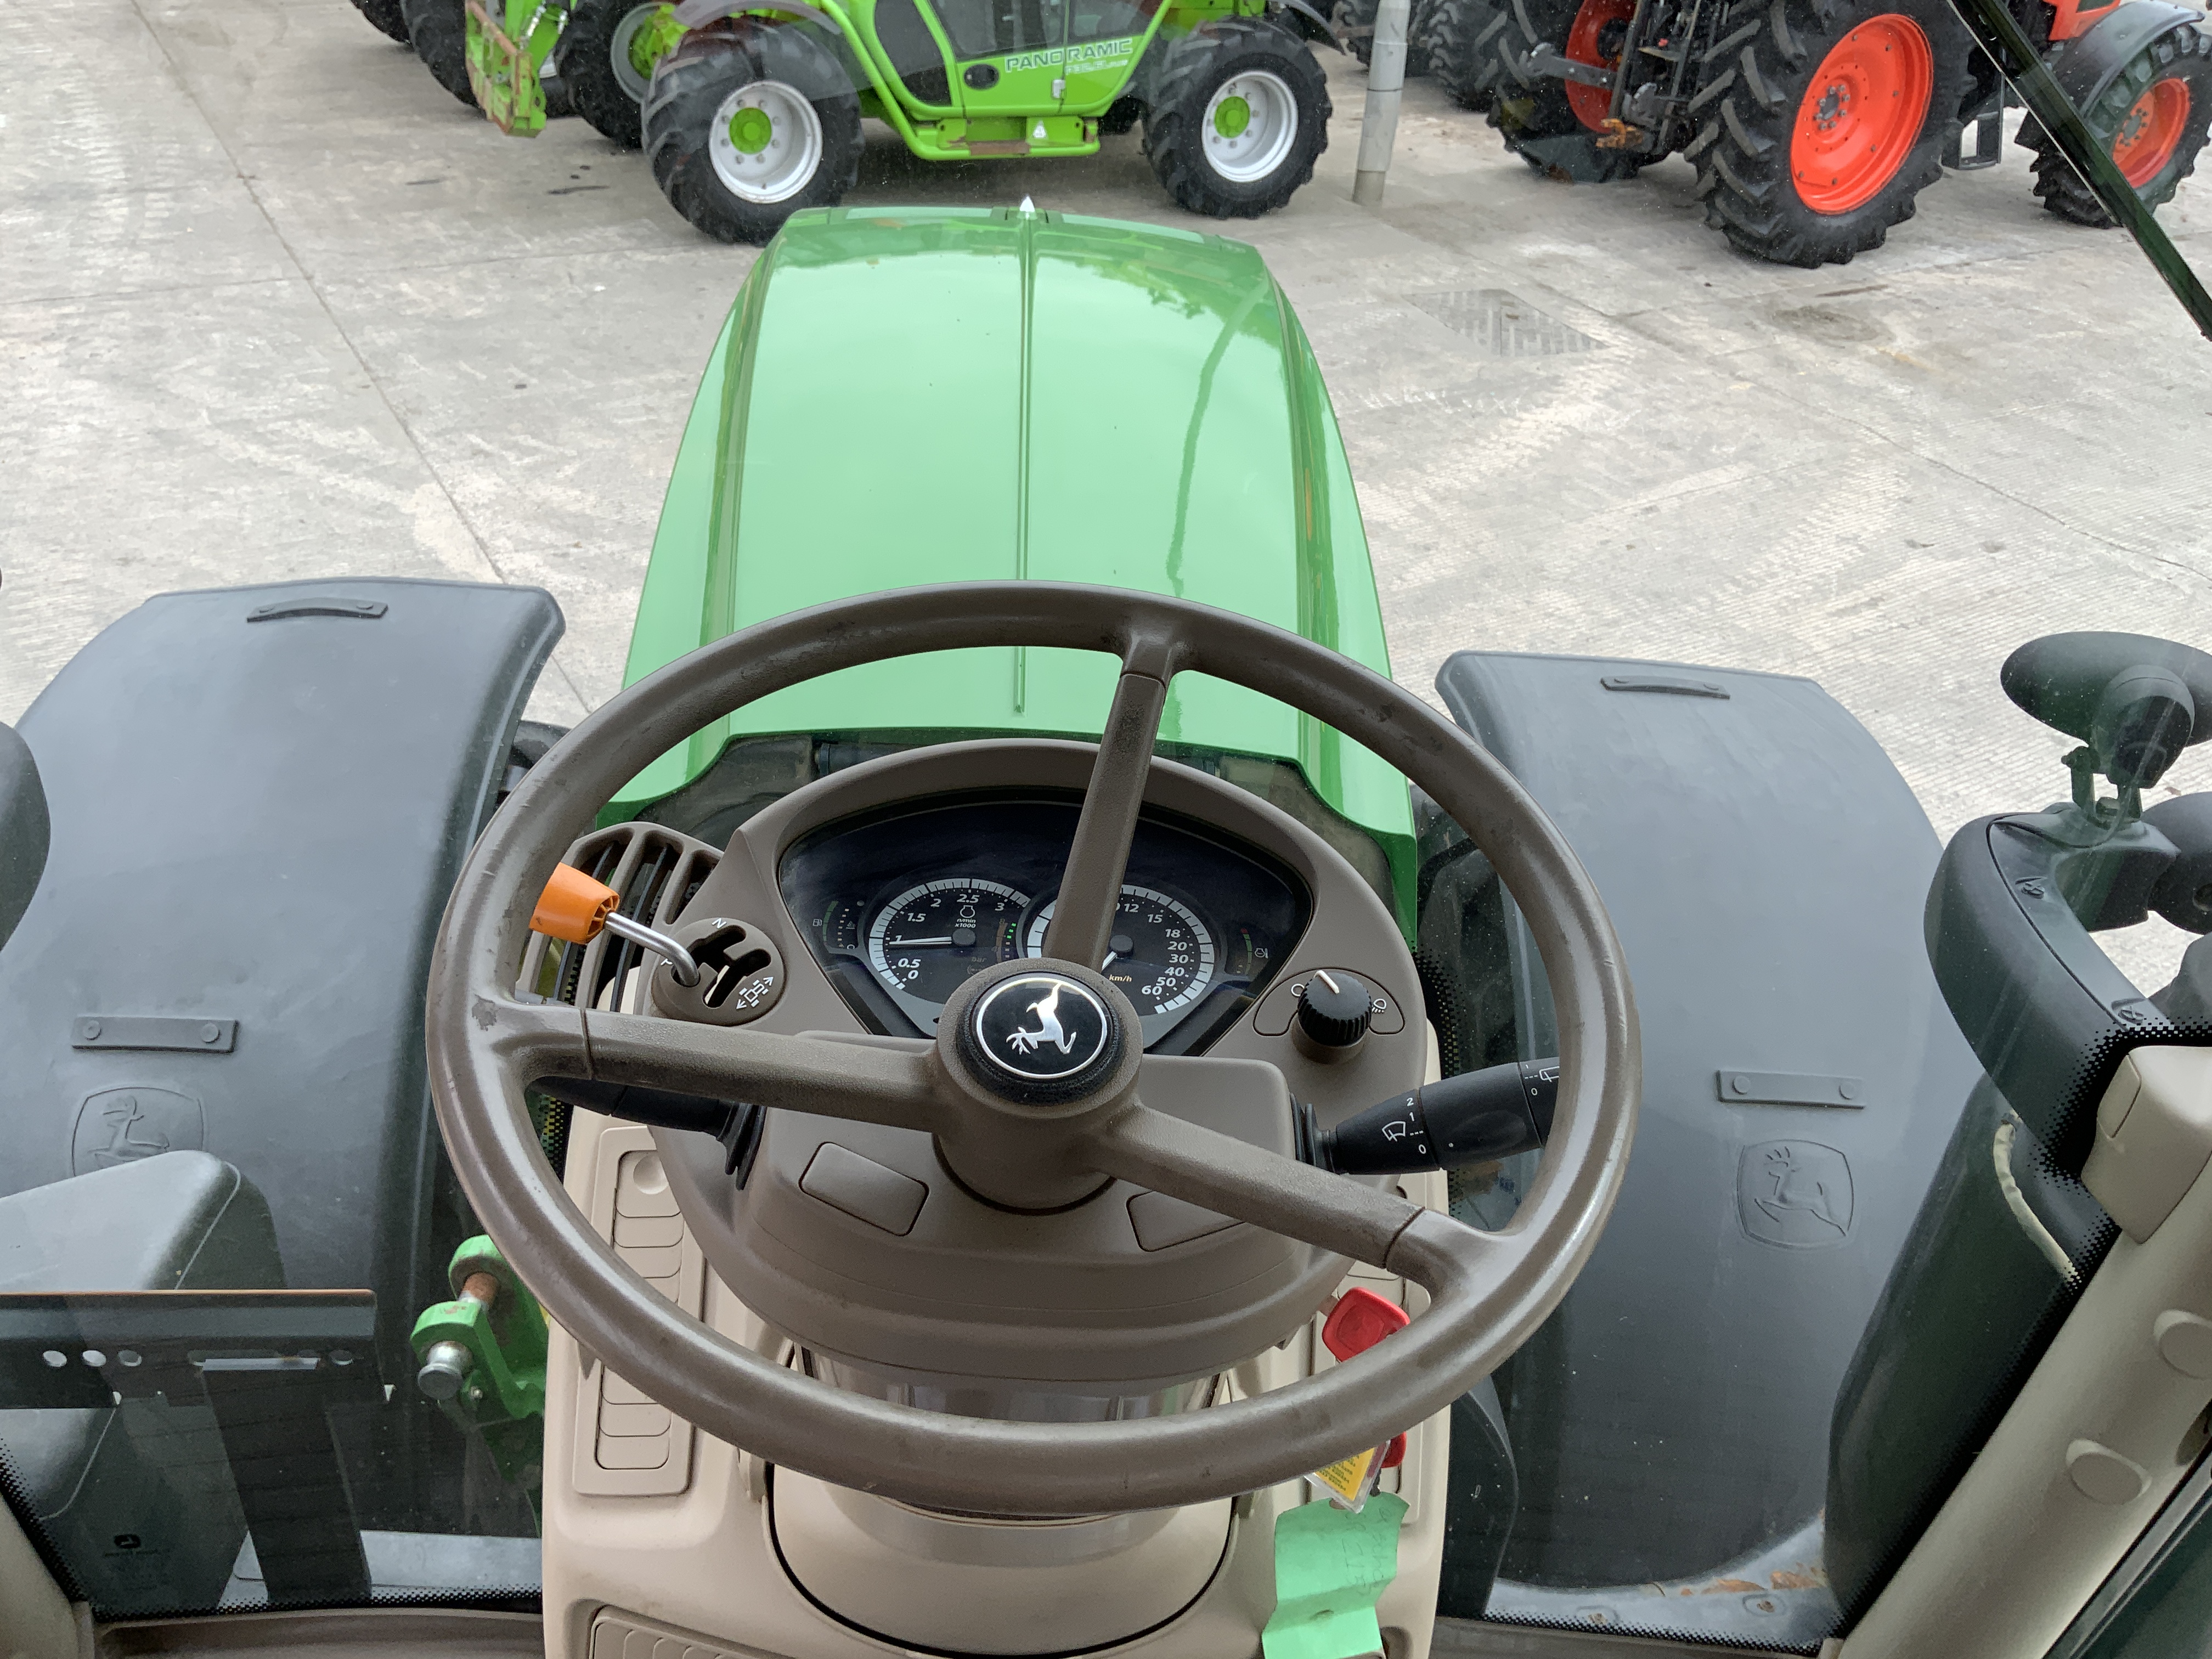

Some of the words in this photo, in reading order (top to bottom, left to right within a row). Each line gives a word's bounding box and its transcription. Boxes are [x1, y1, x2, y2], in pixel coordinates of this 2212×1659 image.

[1005, 38, 1133, 72] PANORAMIC
[930, 898, 941, 906] 2
[956, 894, 979, 903] 2.5
[1124, 904, 1139, 912] 12
[907, 912, 926, 921] 1.5
[1147, 914, 1163, 922] 15
[712, 917, 726, 928] N
[1165, 929, 1180, 938] 18
[1167, 941, 1187, 950] 20
[898, 958, 921, 967] 0.5
[1169, 953, 1188, 963] 30
[908, 969, 918, 979] 0
[1164, 967, 1184, 976] 40
[1155, 977, 1176, 986] 50
[1141, 985, 1162, 995] 60
[1406, 1097, 1414, 1106] 2
[1409, 1111, 1414, 1121] 1
[1418, 1144, 1426, 1154] 0
